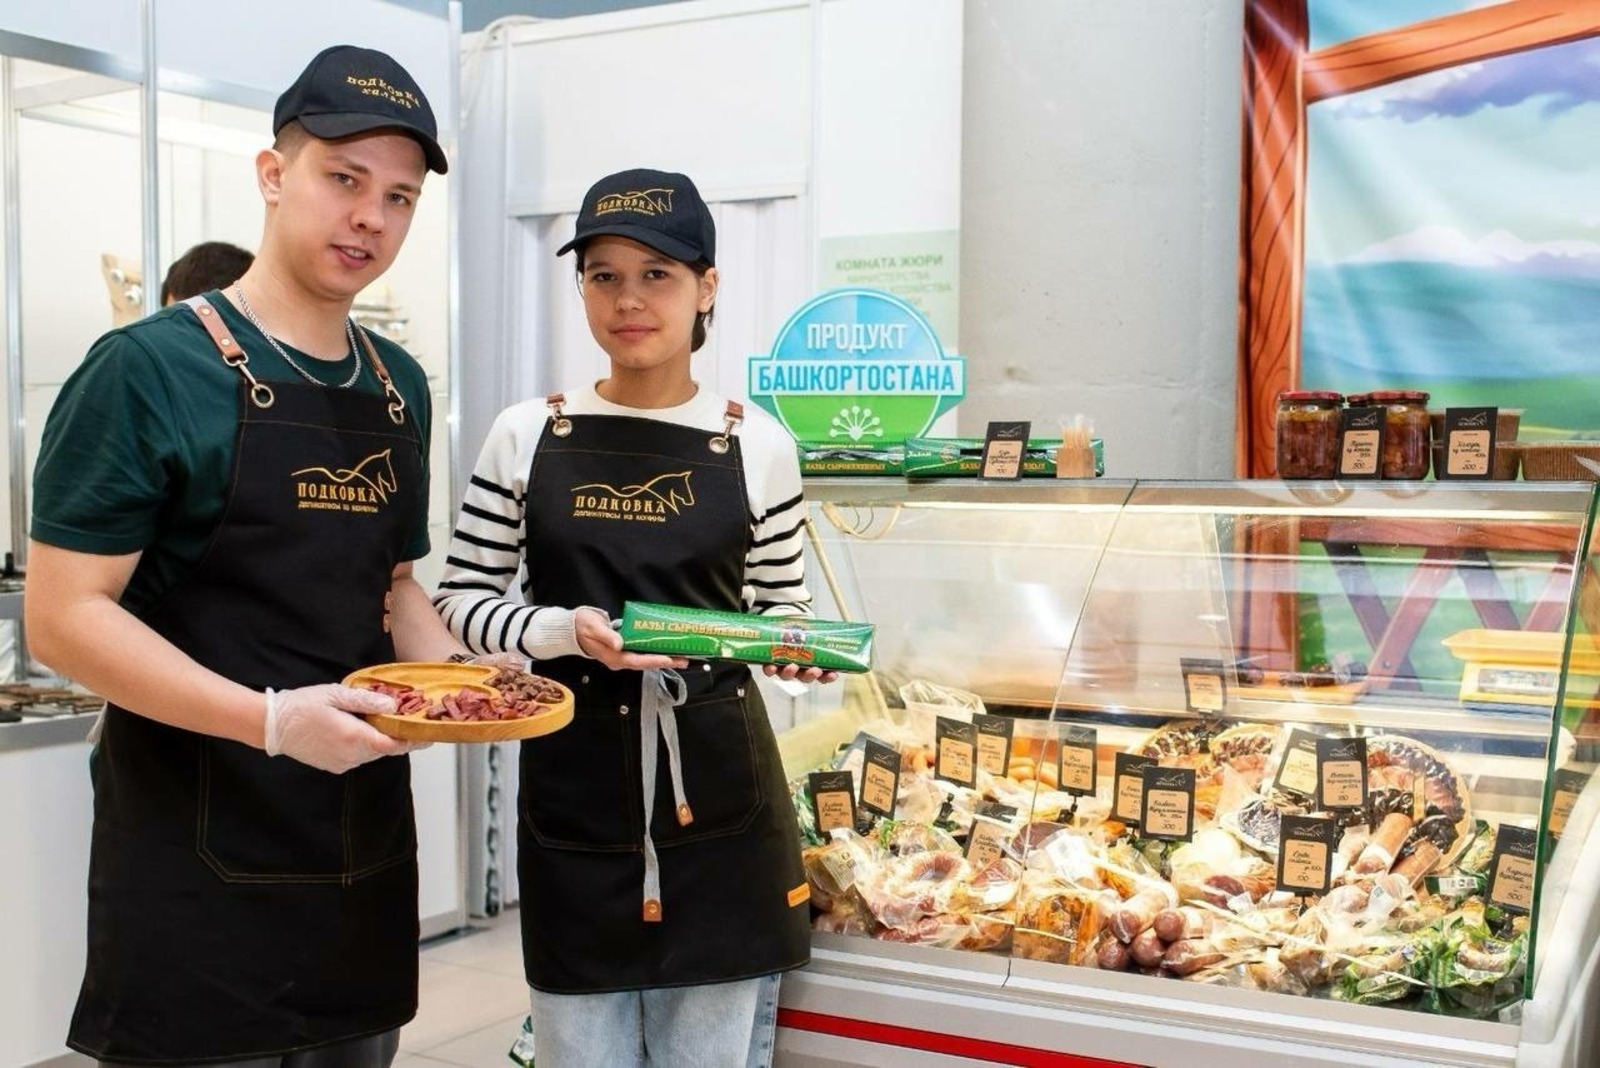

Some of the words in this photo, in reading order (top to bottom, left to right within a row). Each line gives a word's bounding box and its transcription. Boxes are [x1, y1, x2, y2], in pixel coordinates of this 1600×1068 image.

[597, 199, 654, 211] ПОДКОВКА
[836, 258, 897, 270] КОМНАТА
[901, 255, 943, 267] ЖЮРИ
[806, 323, 907, 354] ПРОДУКТ
[758, 365, 955, 391] БАШКОРТОСТАНА
[297, 482, 379, 503] ПОДКОВКА
[575, 496, 667, 514] ПОДКОВКА
[633, 620, 666, 631] КАЗЫ
